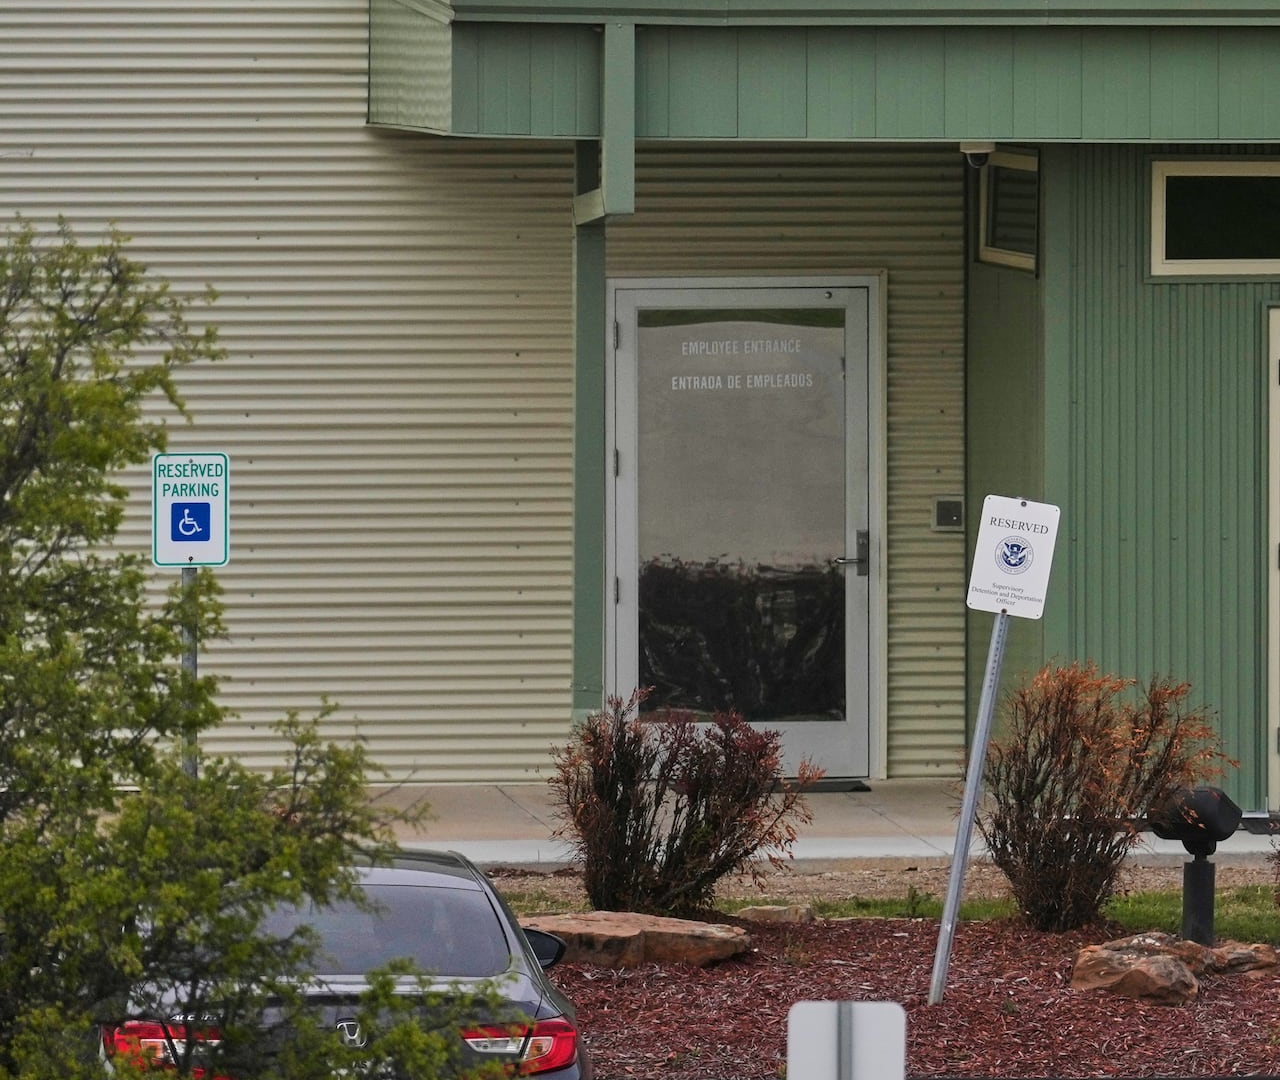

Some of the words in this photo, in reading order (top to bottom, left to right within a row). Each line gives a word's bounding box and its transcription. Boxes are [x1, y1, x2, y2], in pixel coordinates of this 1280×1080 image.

[682, 340, 739, 356] EMPLOYEE
[744, 339, 801, 354] ENTRANCE
[671, 376, 722, 391] ENTRADA
[727, 375, 742, 389] DE
[747, 374, 813, 388] EMPLEADOS
[158, 463, 223, 478] RESERVED
[162, 483, 219, 497] PARKING
[989, 516, 1049, 535] RESERVED
[971, 586, 999, 596] Detention
